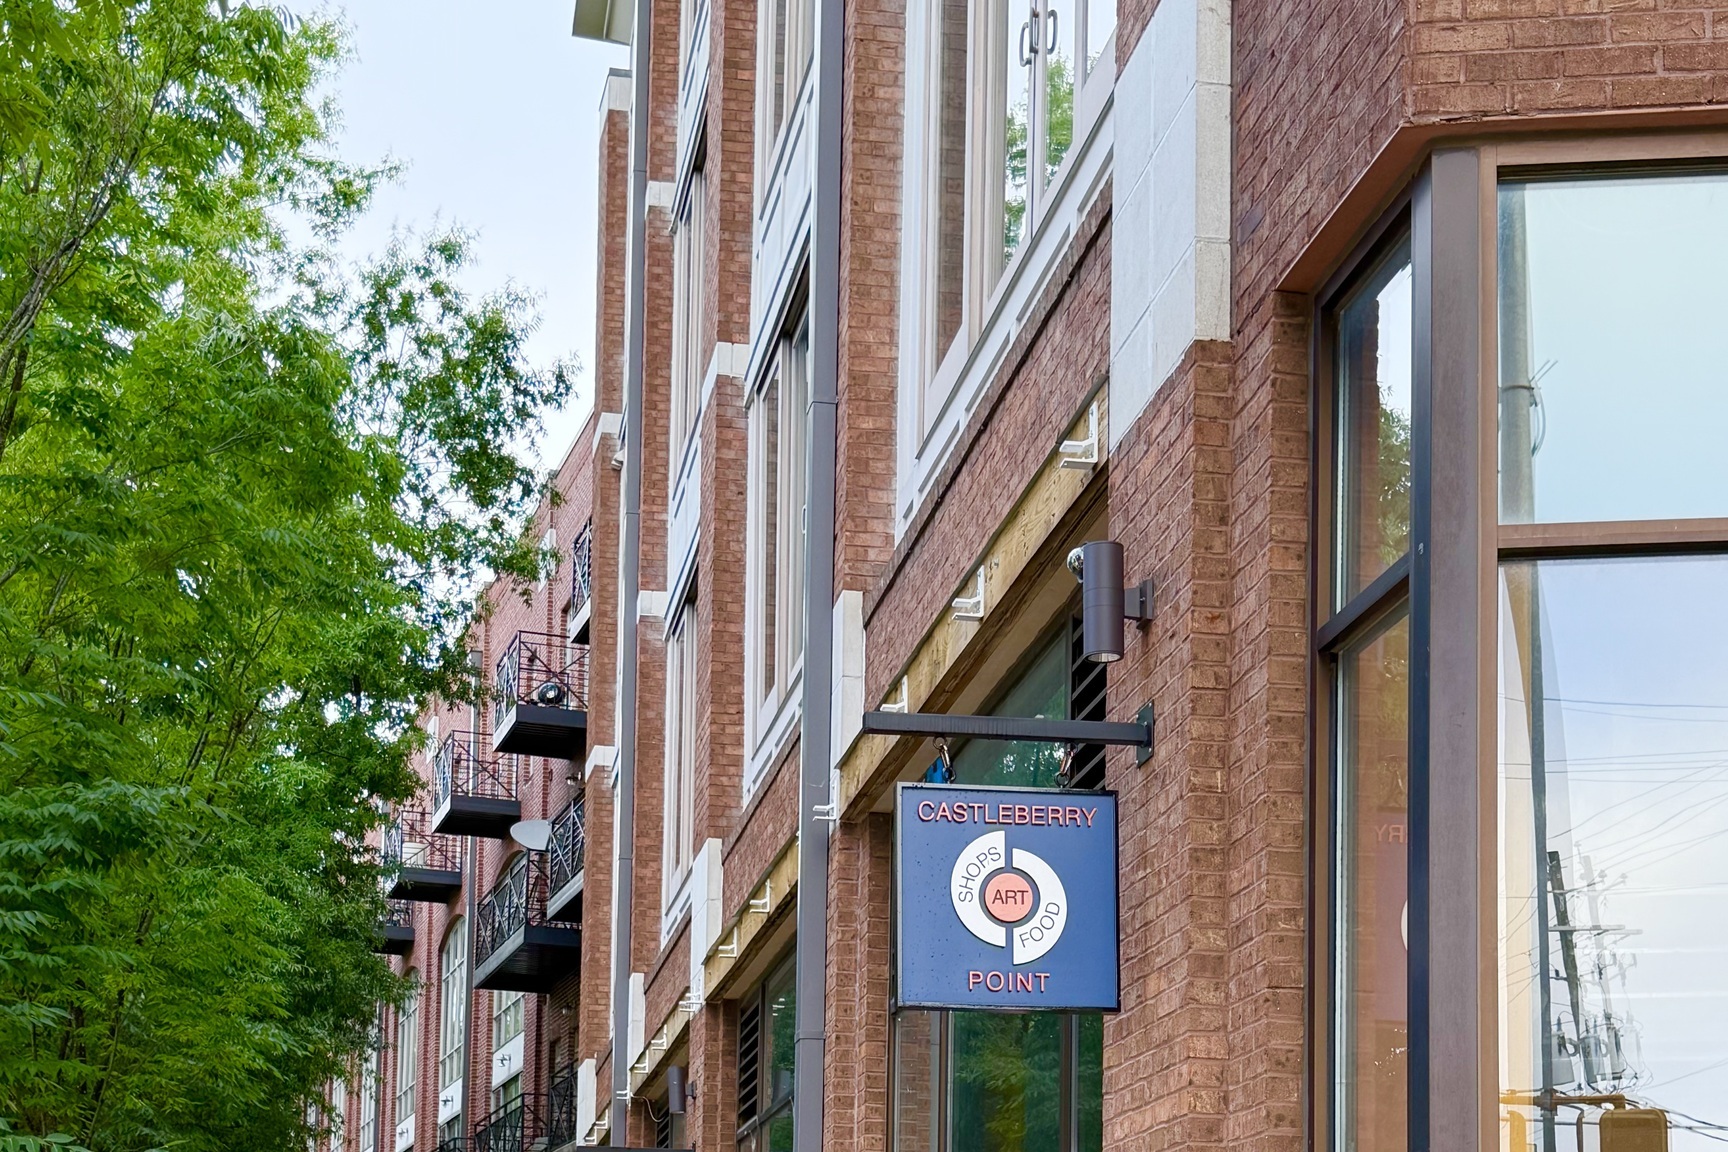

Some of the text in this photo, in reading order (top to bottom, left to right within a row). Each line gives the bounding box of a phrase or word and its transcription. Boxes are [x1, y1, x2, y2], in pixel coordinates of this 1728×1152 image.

[917, 801, 1098, 827] CASTLEBERRY
[958, 846, 1002, 903] SHOPS
[992, 889, 1029, 906] ART
[1018, 901, 1061, 949] FOOD
[967, 970, 1050, 993] POINT
